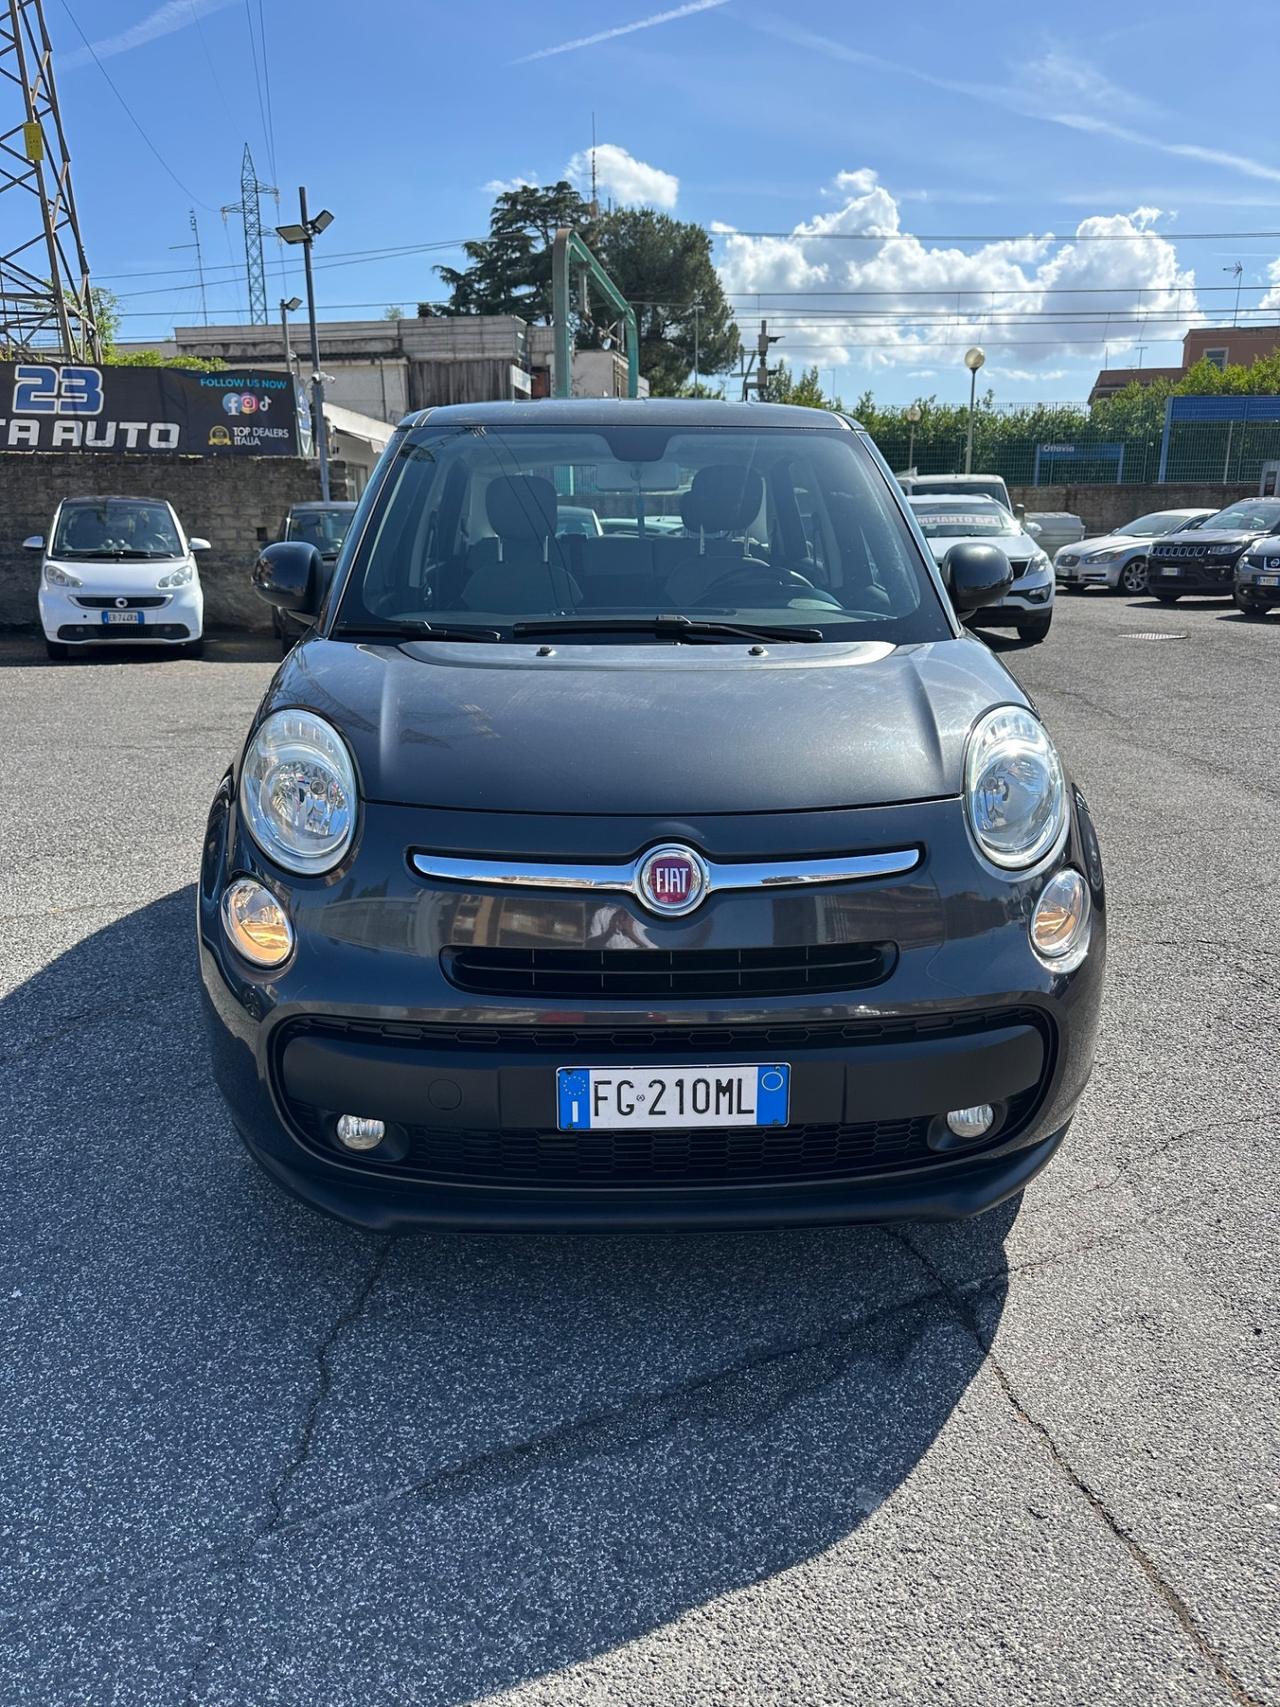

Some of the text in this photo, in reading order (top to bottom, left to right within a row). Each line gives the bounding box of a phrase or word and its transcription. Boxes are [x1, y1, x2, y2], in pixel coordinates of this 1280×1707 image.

[12, 365, 104, 415] 23
[200, 378, 287, 389] FOLLOW US NOW
[0, 419, 180, 449] A AUTO
[232, 427, 289, 438] TOP DEALERS
[234, 436, 261, 446] ITALIA
[656, 867, 689, 893] FIAT
